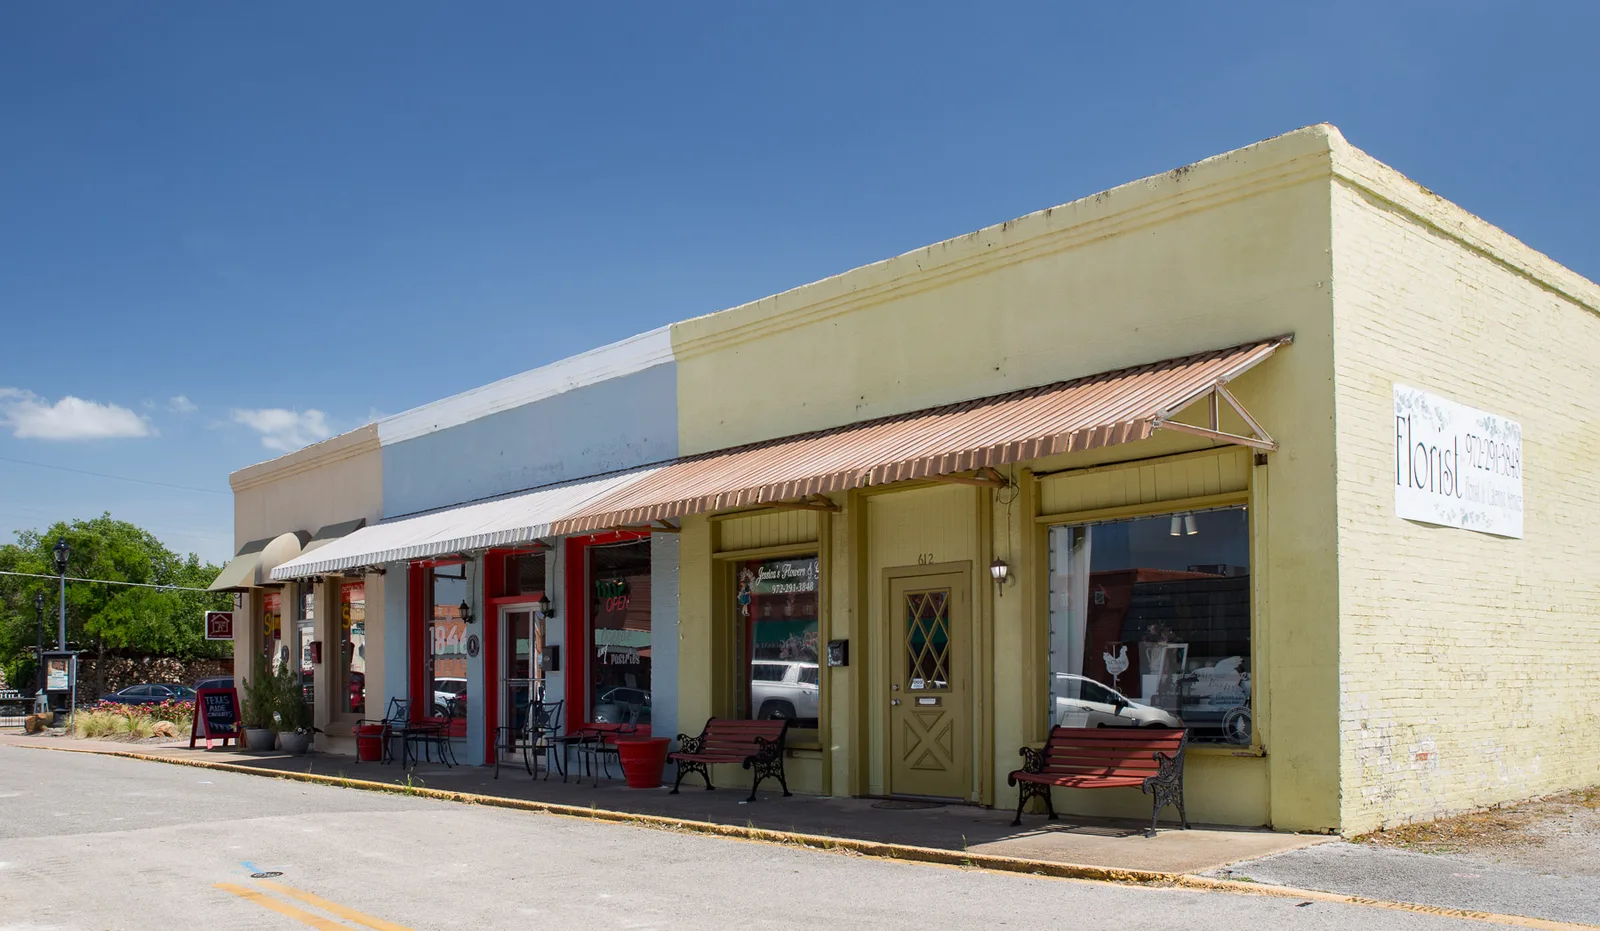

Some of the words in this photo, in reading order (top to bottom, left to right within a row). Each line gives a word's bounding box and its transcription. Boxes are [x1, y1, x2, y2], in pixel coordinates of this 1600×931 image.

[1396, 412, 1463, 499] Florist
[918, 553, 934, 566] 612
[782, 563, 806, 579] Flowers
[772, 582, 814, 594] 972-291-3848
